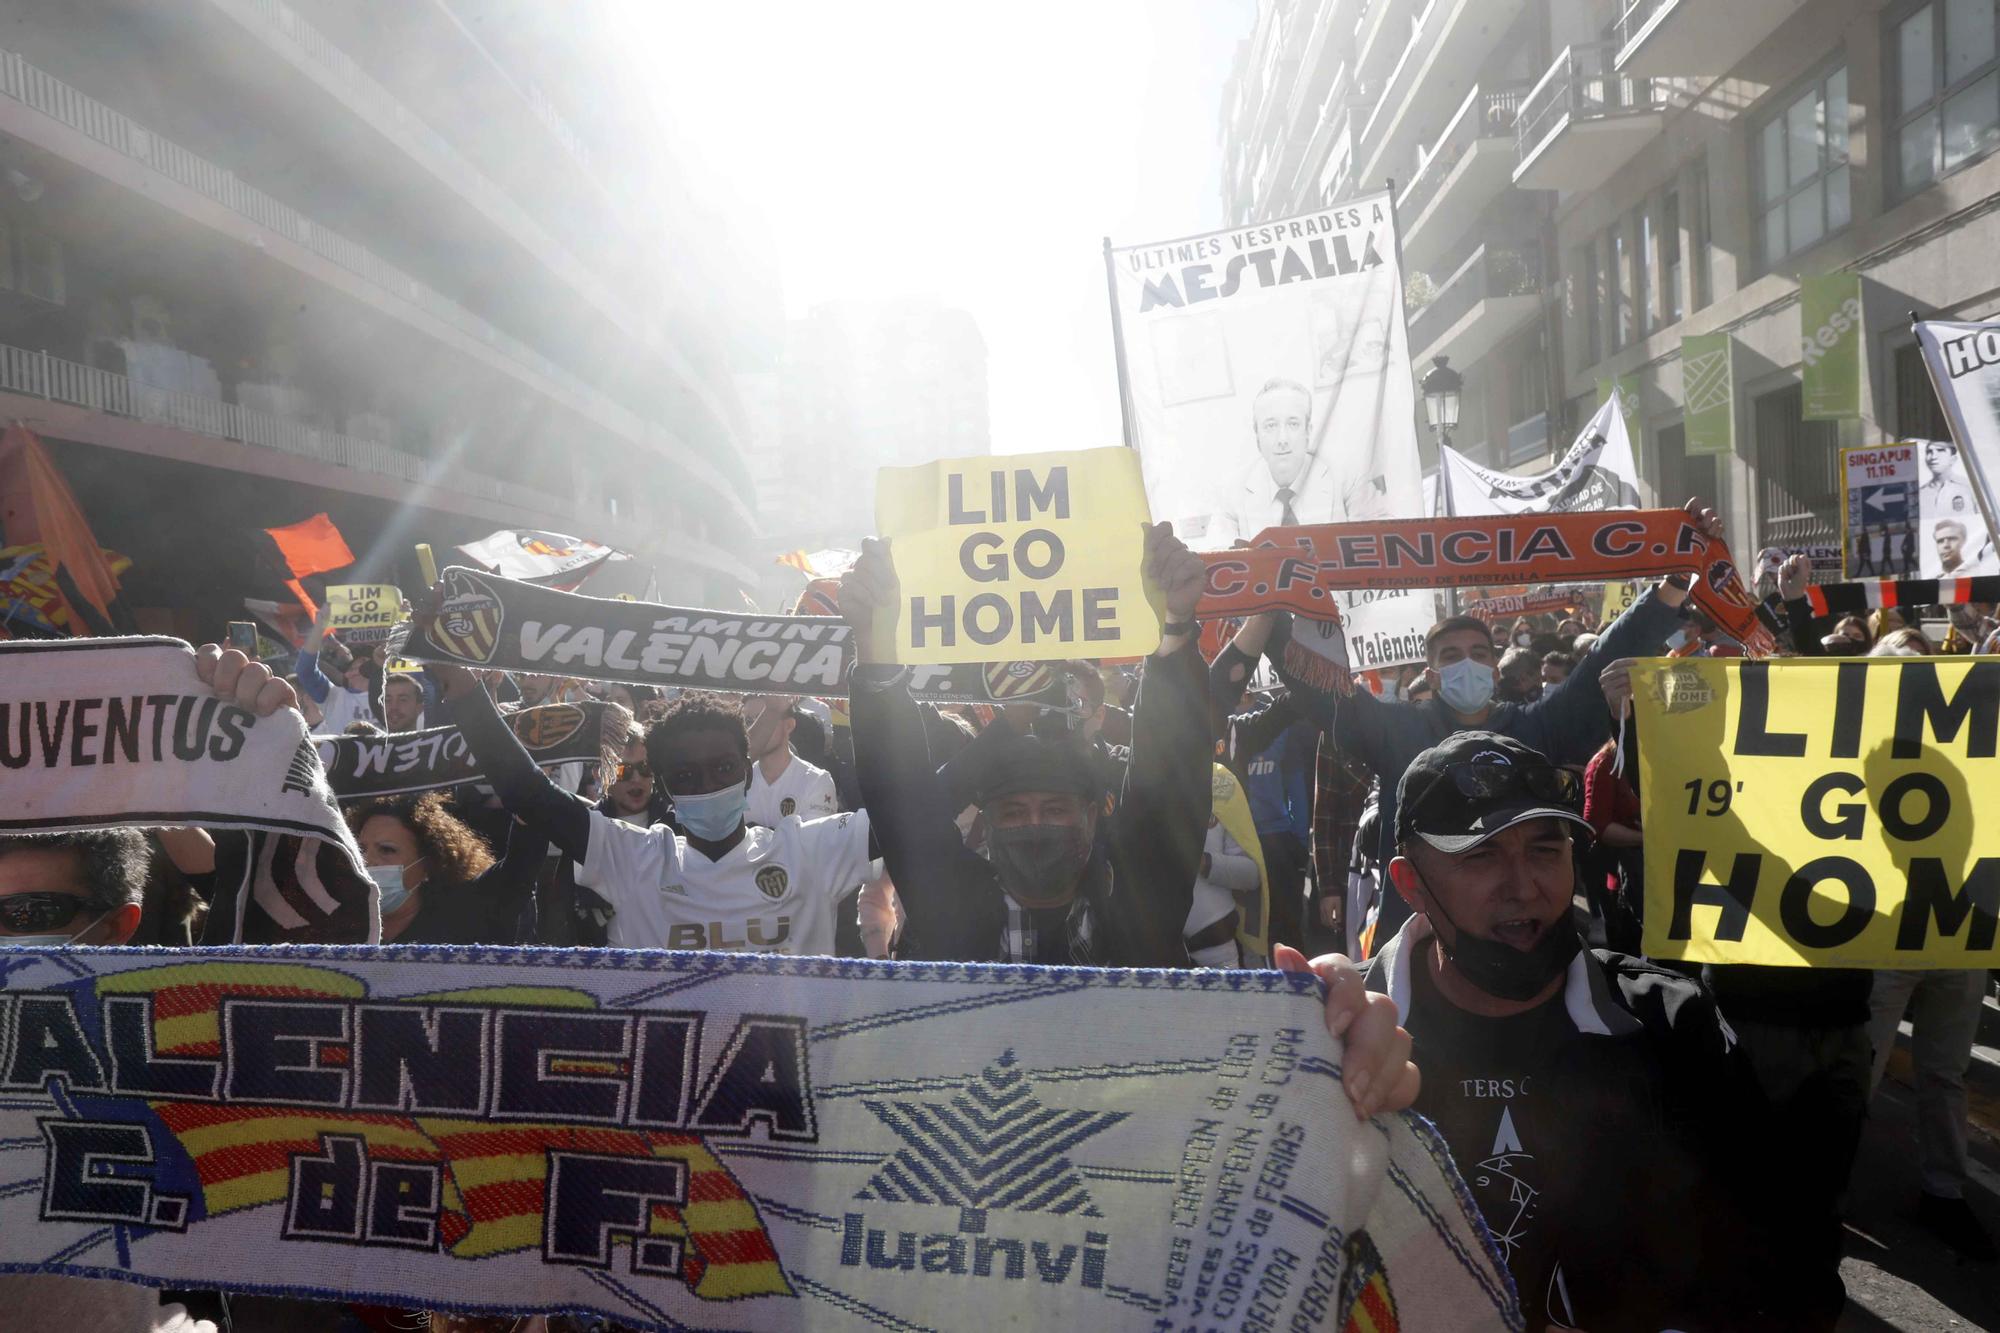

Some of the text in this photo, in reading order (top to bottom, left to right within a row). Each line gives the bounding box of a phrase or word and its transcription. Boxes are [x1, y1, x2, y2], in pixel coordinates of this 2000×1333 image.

[1232, 208, 1361, 251] VESPRADES
[1372, 203, 1384, 223] A
[1139, 230, 1384, 313] MESTALLA
[1849, 449, 1911, 467] SINGAPUR
[948, 466, 1070, 525] LIM
[959, 529, 1065, 582] GO
[1435, 575, 1454, 586] DE
[1459, 572, 1540, 585] MESTALLA
[333, 612, 390, 625] HOME
[348, 587, 381, 600] LIM
[350, 601, 378, 613] GO
[911, 588, 1121, 648] HOME
[520, 621, 843, 686] VALENCIA
[653, 617, 853, 643] AMUNT
[1352, 627, 1426, 666] València
[1733, 661, 2000, 759] LIM
[1684, 778, 1743, 817] 19'
[1800, 772, 1950, 842] GO
[0, 991, 818, 1143] ALENCIA
[1218, 1033, 1262, 1079] LIGA
[1206, 1086, 1241, 1112] de
[1171, 1118, 1224, 1229] CAMPEON
[1190, 1028, 1305, 1317] veces CAMPEON de COPA
[281, 1131, 442, 1252] de
[542, 1147, 688, 1278] F.
[1211, 1121, 1305, 1321] COPAS de FERIAS
[840, 1213, 1109, 1288] luanvi
[1164, 1236, 1193, 1308] veces
